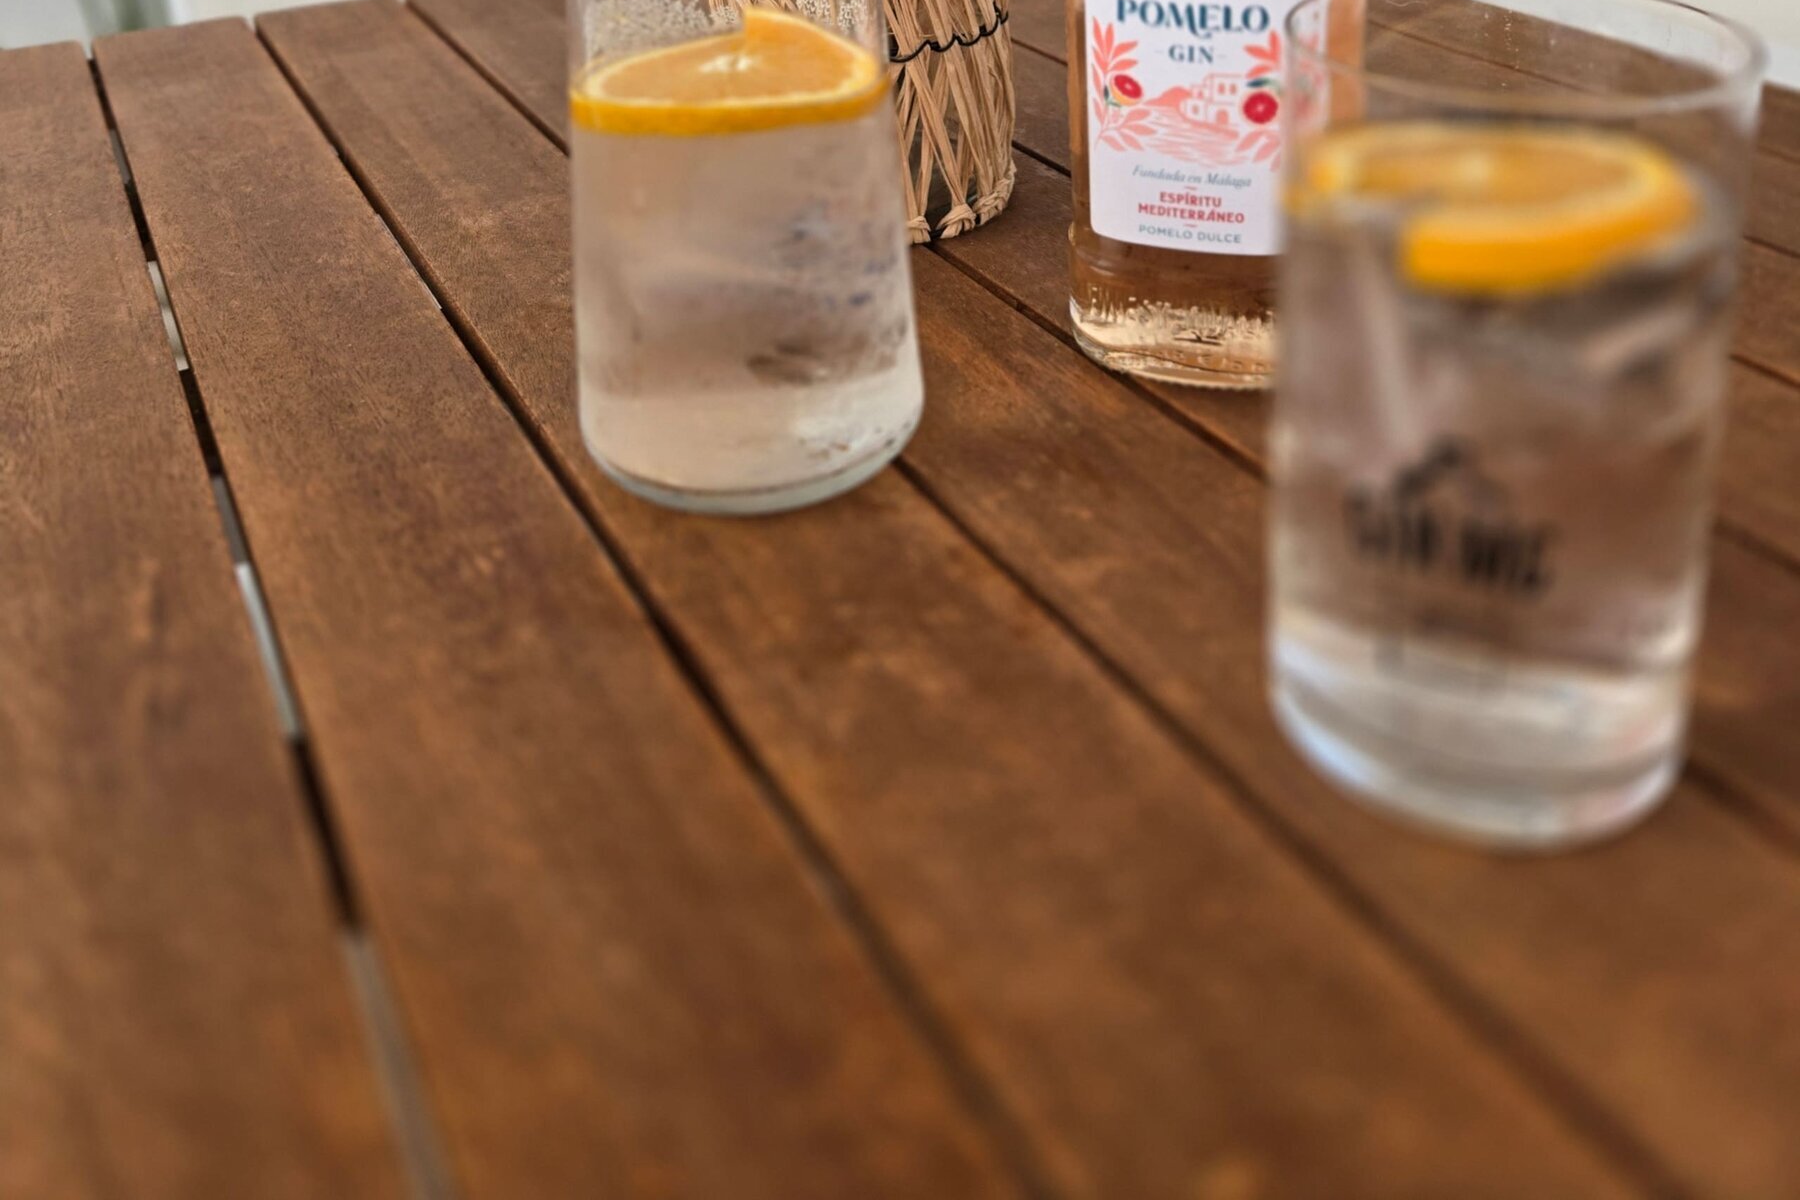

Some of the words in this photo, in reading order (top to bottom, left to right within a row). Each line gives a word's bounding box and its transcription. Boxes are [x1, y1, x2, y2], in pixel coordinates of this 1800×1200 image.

[1168, 44, 1214, 64] GIN
[1187, 176, 1202, 184] en
[1159, 191, 1222, 208] ESPÍRITU
[1138, 202, 1245, 223] MEDITERRÁNEO
[1138, 224, 1193, 239] POMELO
[1197, 231, 1242, 244] DULCE
